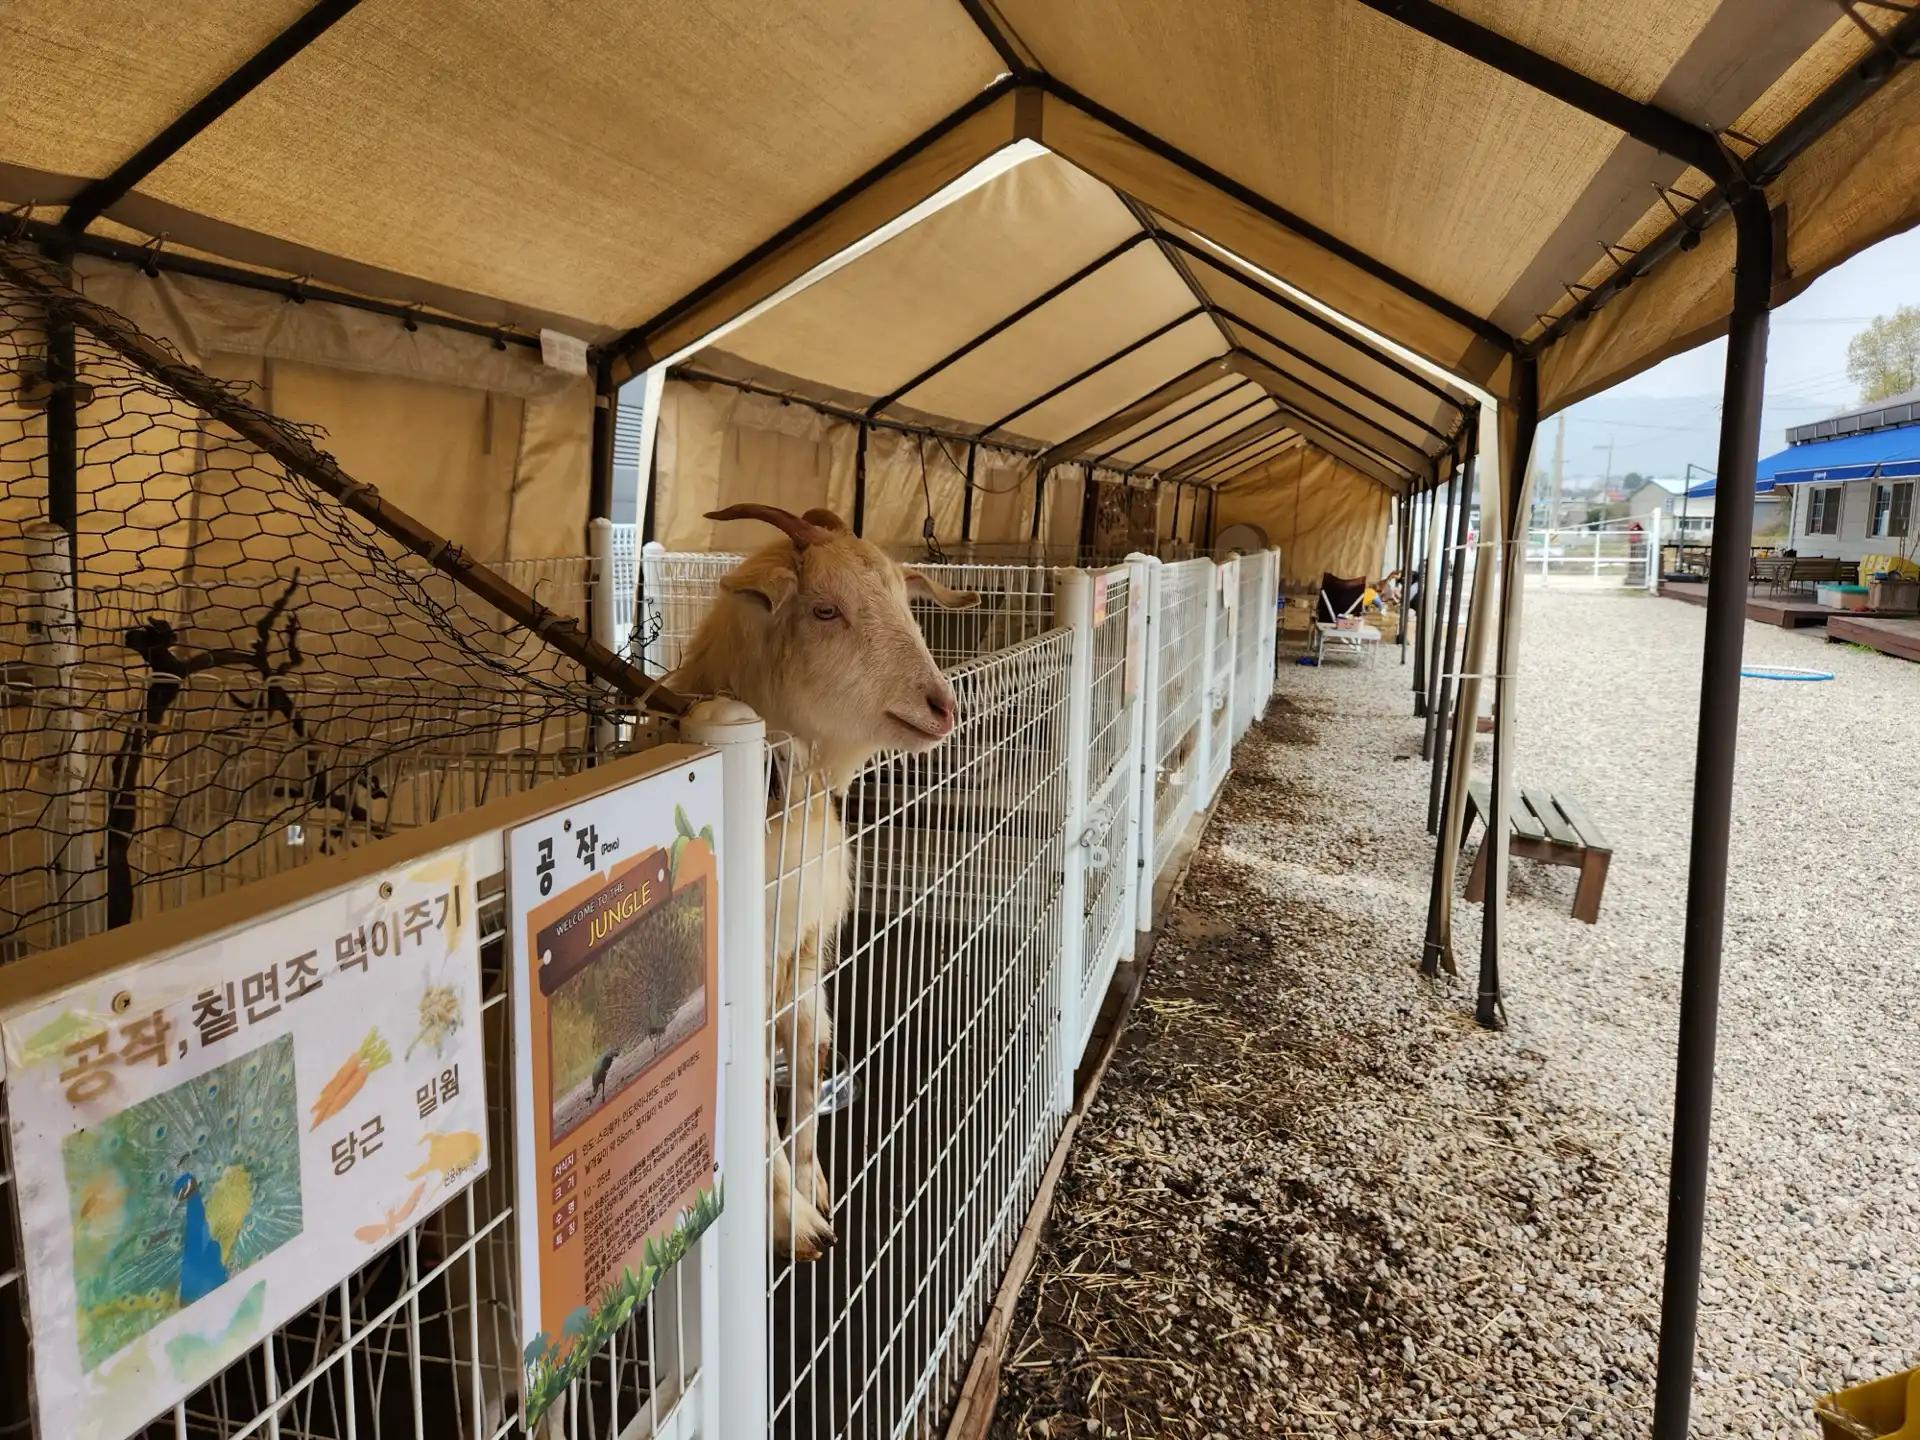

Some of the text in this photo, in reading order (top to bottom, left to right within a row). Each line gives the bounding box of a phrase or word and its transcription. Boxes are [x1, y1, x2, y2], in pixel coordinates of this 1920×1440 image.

[335, 885, 463, 975] 먹이주기
[556, 882, 625, 936] WELCOME TO THE
[588, 880, 652, 947] JUNGLE
[416, 1064, 459, 1119] 밀웜
[331, 1115, 384, 1176] 당근
[555, 1153, 574, 1177] 서식지
